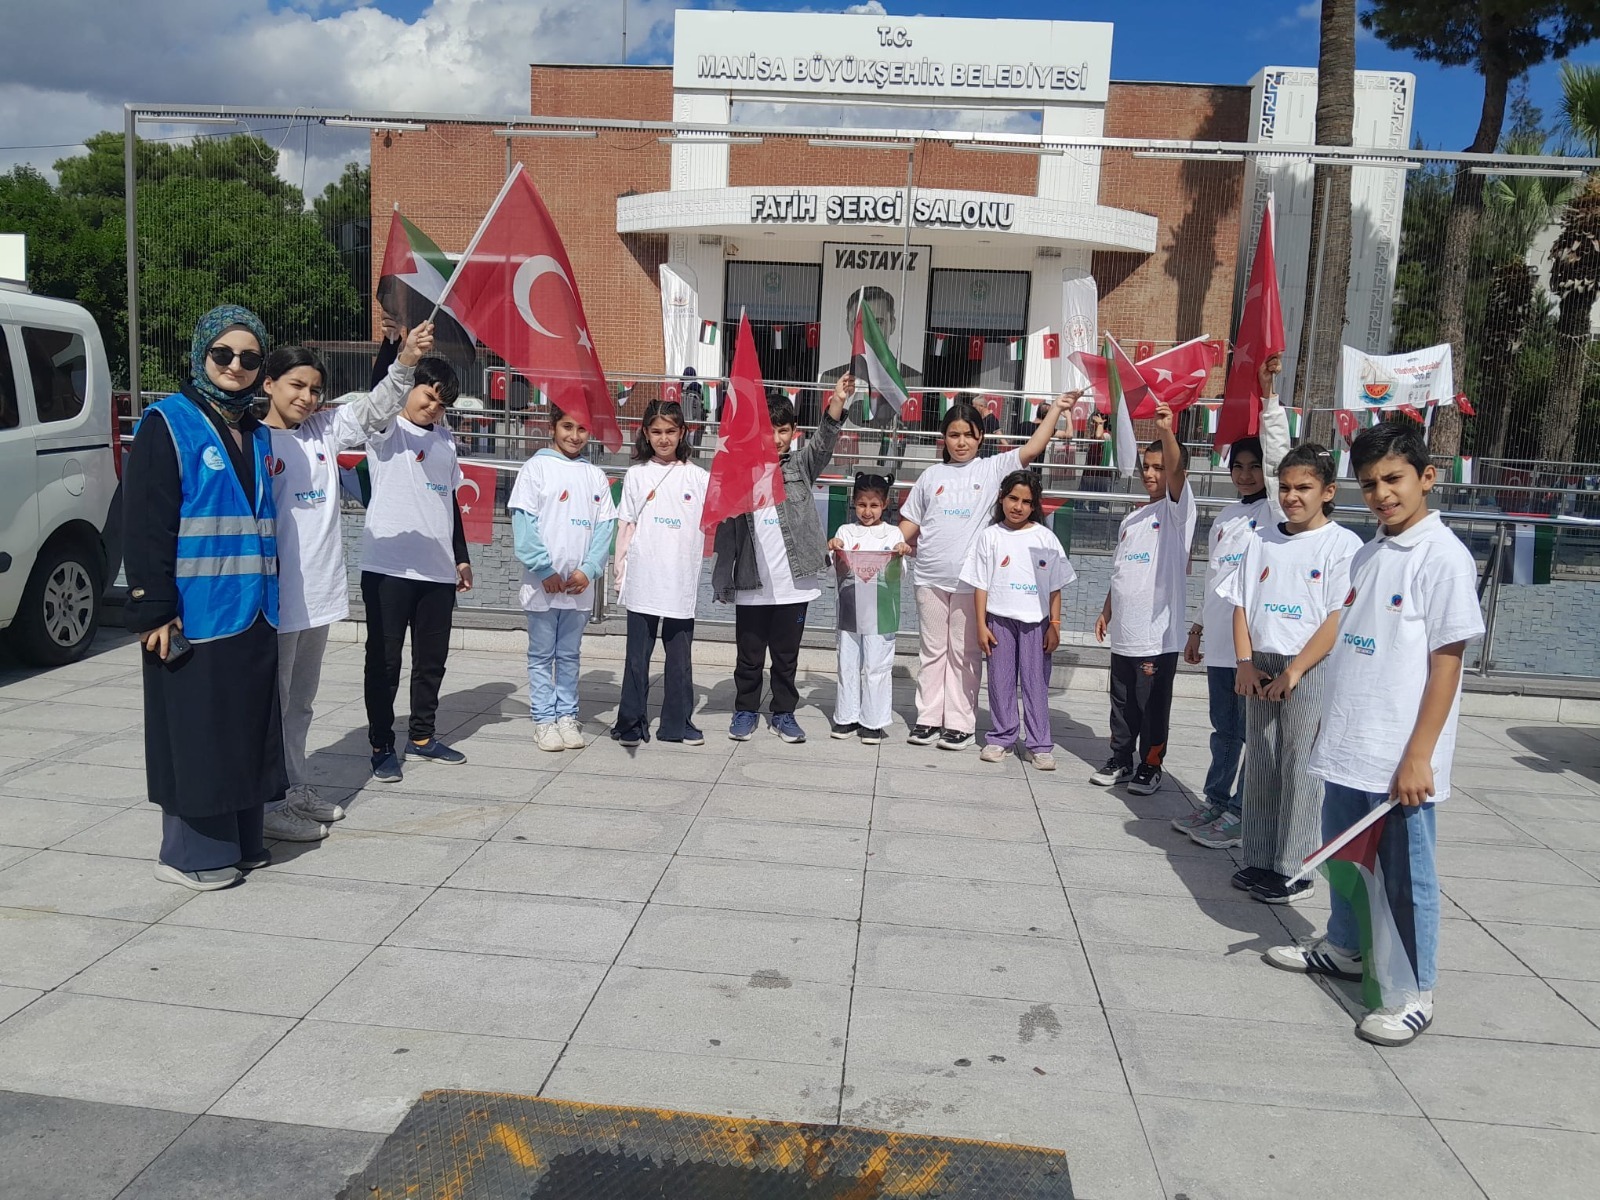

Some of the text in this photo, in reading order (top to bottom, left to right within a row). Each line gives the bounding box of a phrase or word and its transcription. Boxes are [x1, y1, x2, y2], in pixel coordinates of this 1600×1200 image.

[877, 26, 912, 47] T.C.
[698, 52, 1089, 90] MANİSA BÜYÜKŞEHİR BELEDİYESİ
[750, 190, 1015, 228] FATİH SERGİ SALONU
